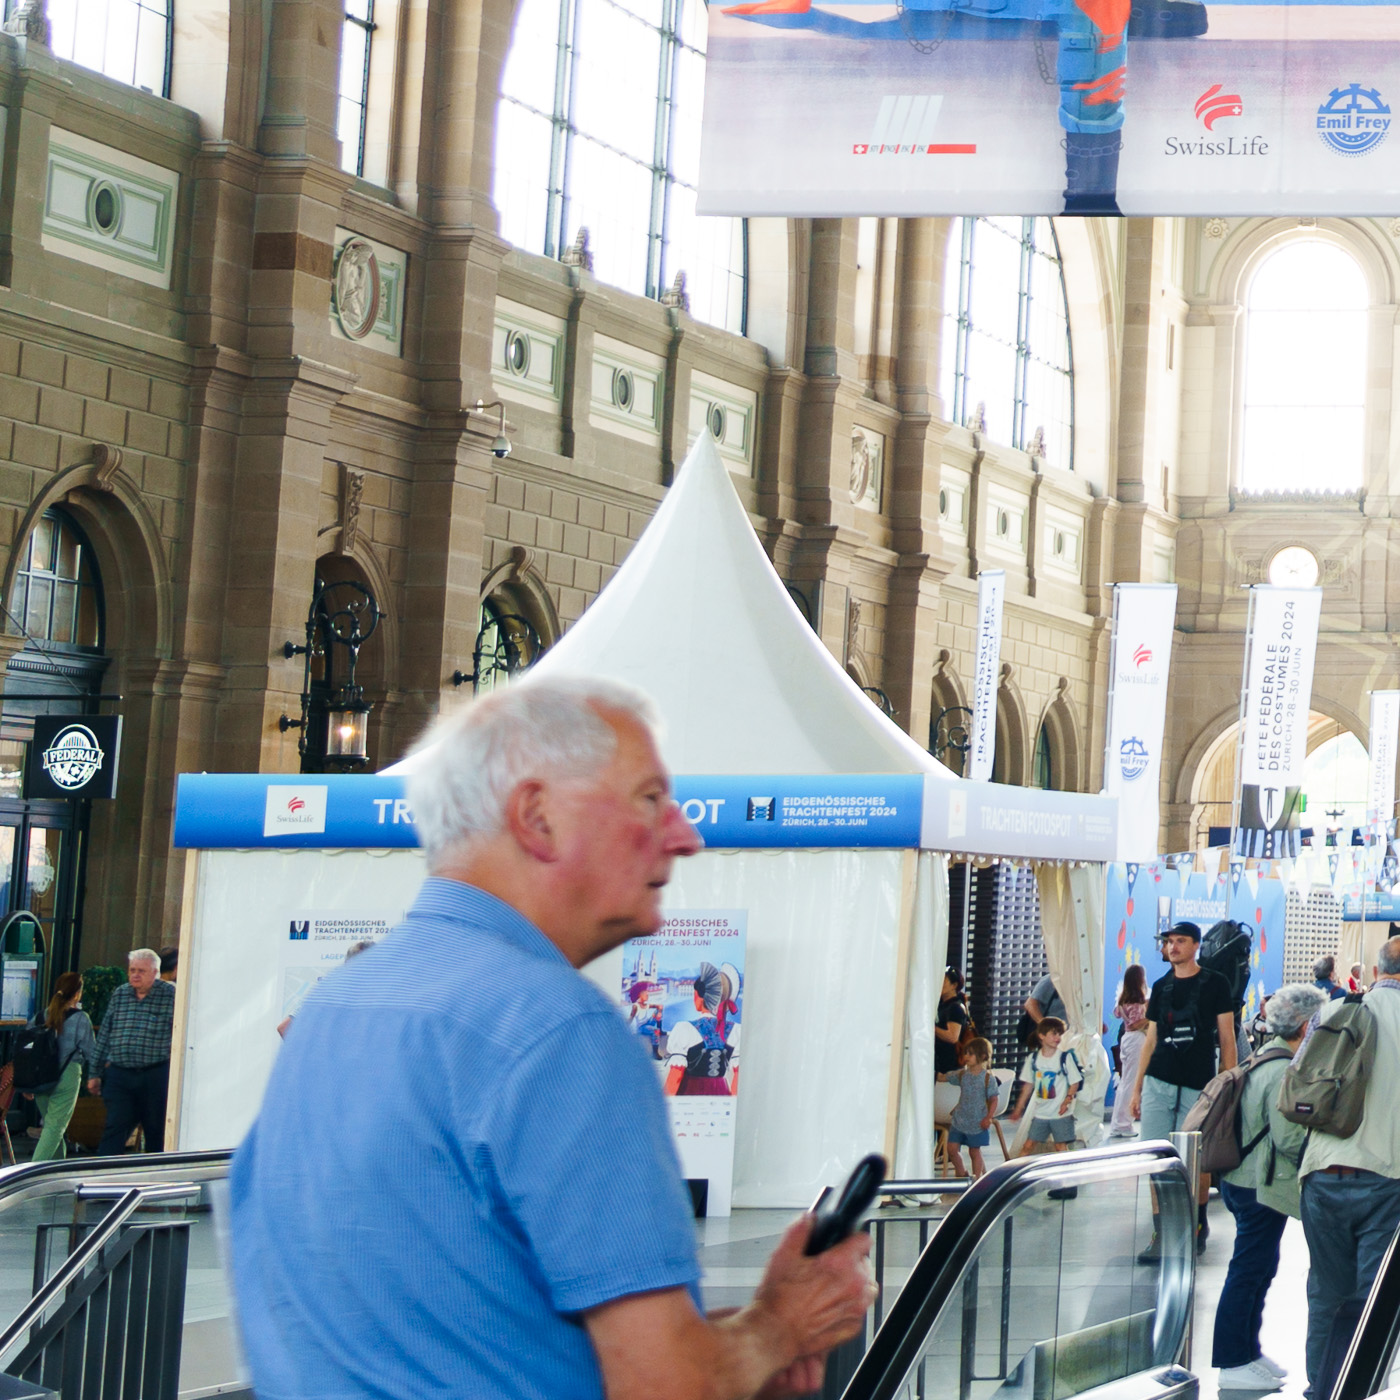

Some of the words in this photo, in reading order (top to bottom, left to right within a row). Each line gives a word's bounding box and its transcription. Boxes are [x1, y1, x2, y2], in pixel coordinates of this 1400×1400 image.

[1317, 115, 1350, 129] Emil
[1356, 115, 1391, 133] Frey
[1281, 601, 1295, 640] 2024
[1291, 647, 1302, 677] JUIN
[1272, 645, 1291, 736] COSTUMES
[49, 749, 97, 763] FEDERAL
[1268, 741, 1281, 771] DES
[1132, 757, 1149, 768] Frey
[783, 796, 886, 806] EIDGENÖSSISCHES
[782, 807, 867, 816] TRACHTENFEST
[870, 807, 897, 816] 2024
[782, 818, 816, 826] ZÜRICH,
[315, 919, 386, 927] EIDGENÖSSISCHES
[663, 918, 728, 927] NÖSSISCHES
